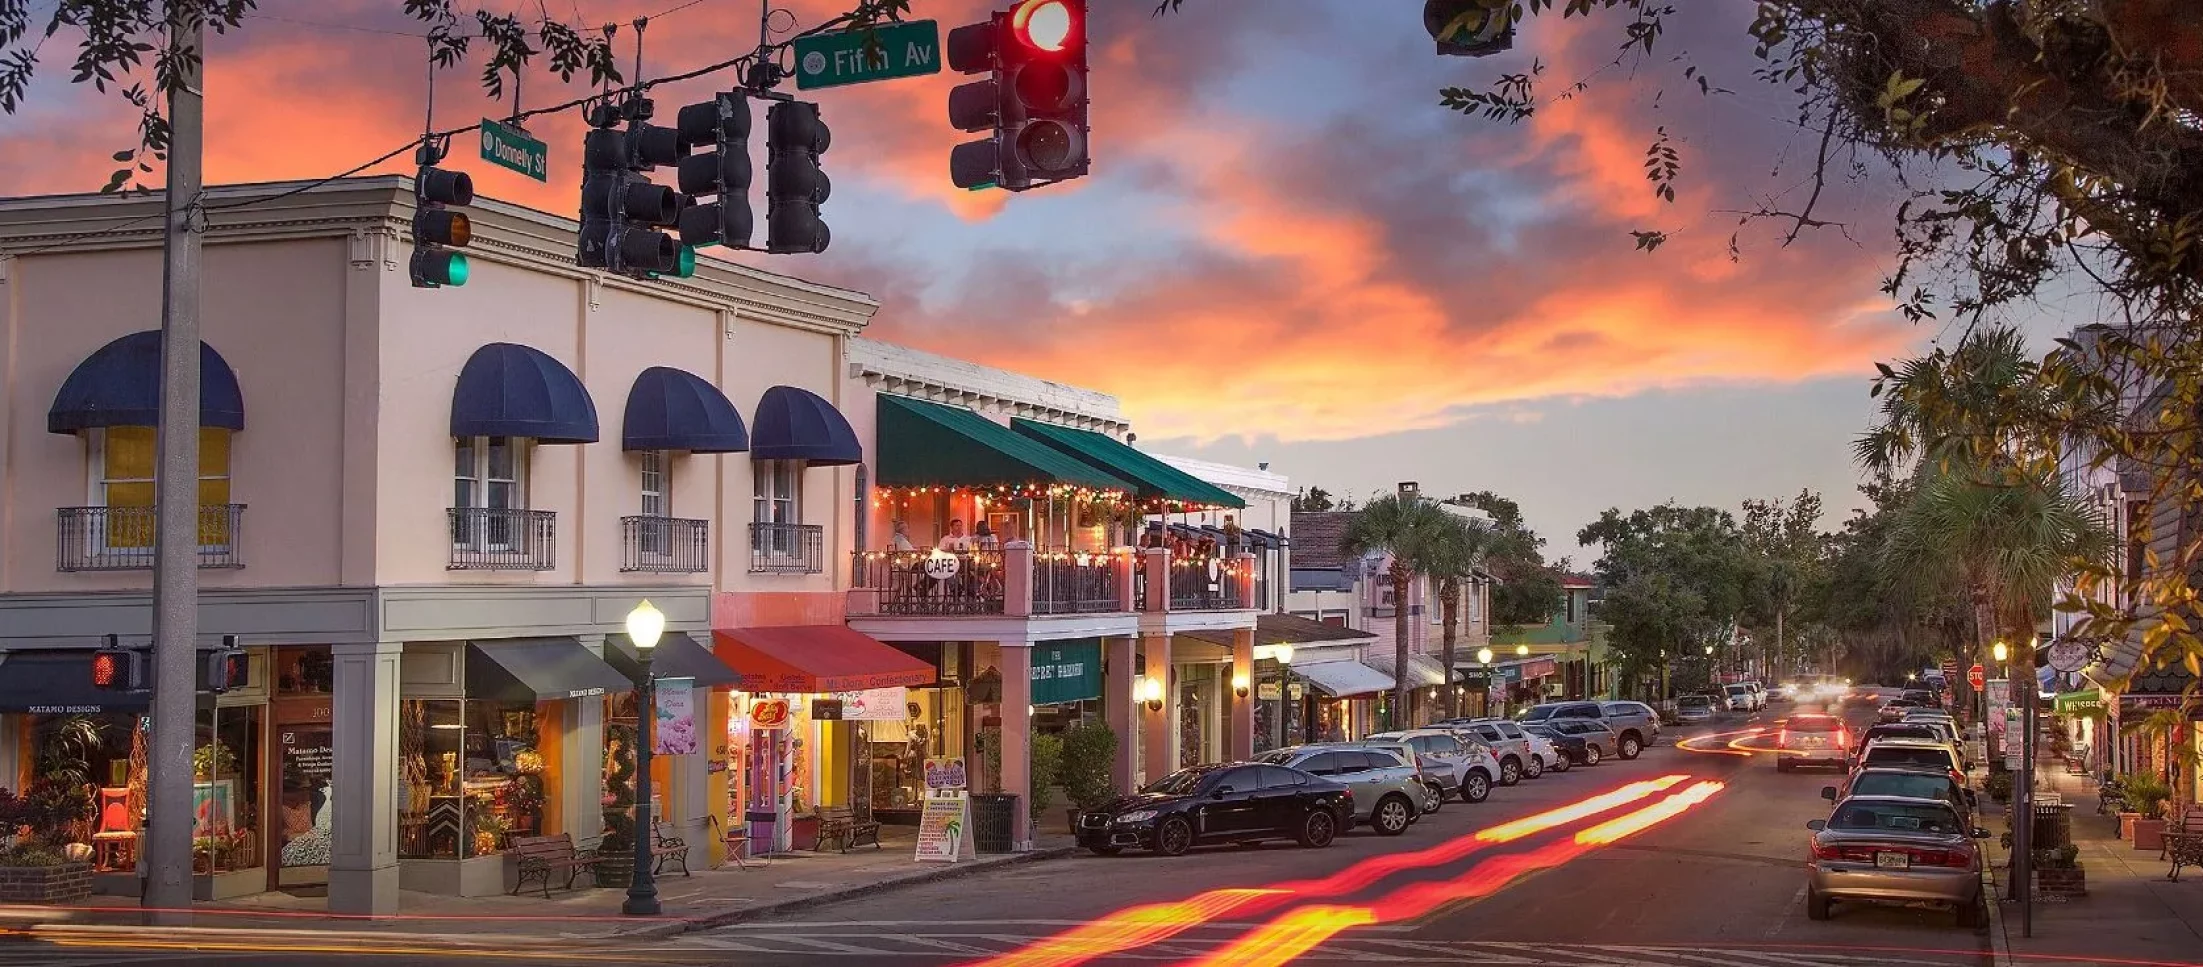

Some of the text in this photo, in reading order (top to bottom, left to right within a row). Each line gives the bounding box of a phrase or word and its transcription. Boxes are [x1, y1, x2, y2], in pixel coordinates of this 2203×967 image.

[904, 41, 931, 67] Av
[495, 136, 546, 174] Donnelly St
[1032, 665, 1055, 680] ECRET
[1468, 671, 1492, 679] SHOS
[1969, 671, 1983, 681] STO
[28, 704, 101, 714] MATAMO DESIGNS
